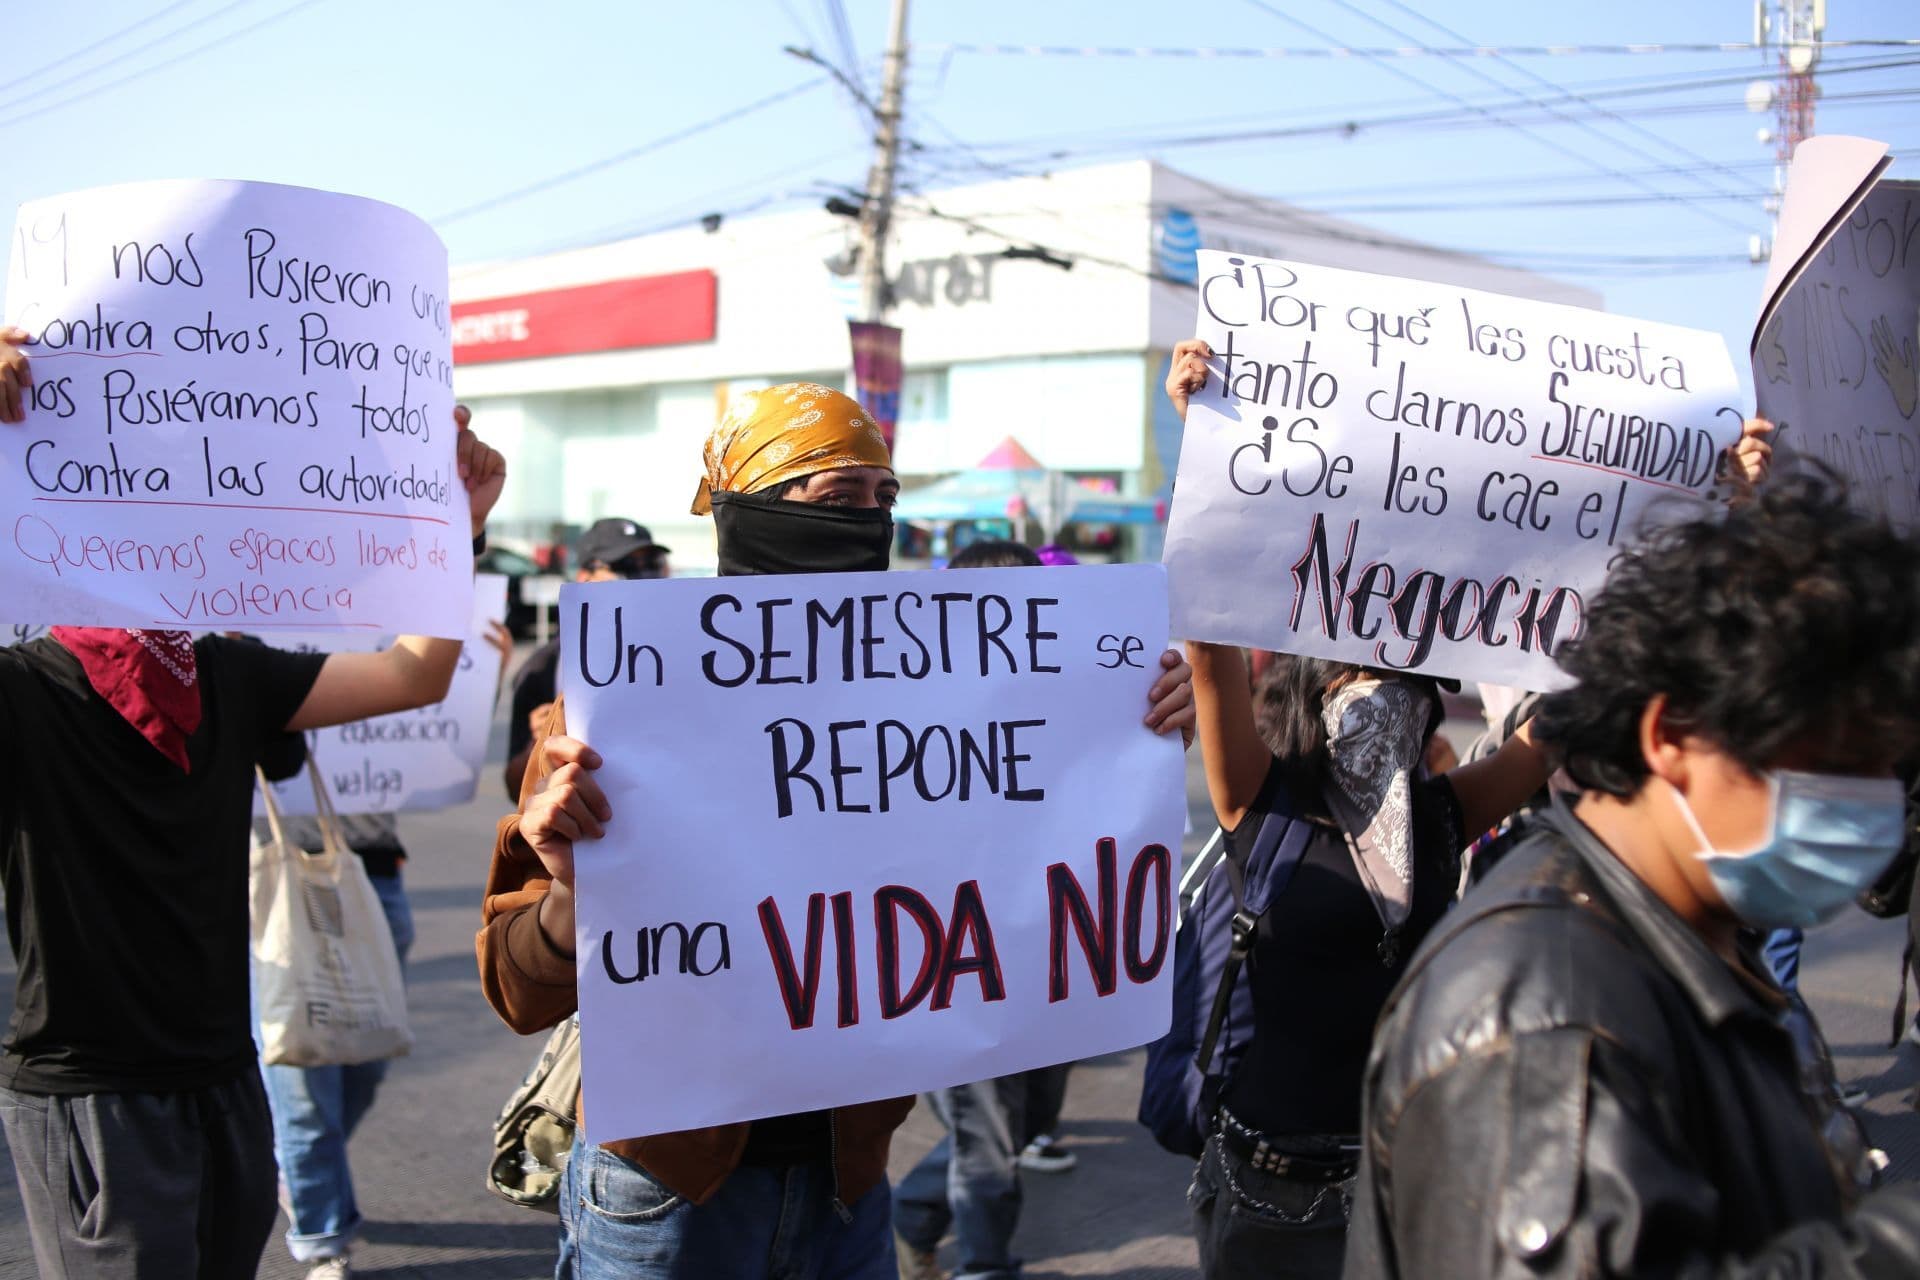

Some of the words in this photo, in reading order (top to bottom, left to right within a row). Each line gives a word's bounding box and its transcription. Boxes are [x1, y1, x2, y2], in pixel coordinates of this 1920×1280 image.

[114, 232, 203, 287] nos
[245, 227, 391, 308] Pusieron
[173, 311, 284, 357] otros,
[299, 312, 379, 375] Para
[394, 344, 433, 406] que
[1201, 257, 1328, 332] ¿Por
[1346, 307, 1438, 368] qué
[1461, 297, 1528, 363] les
[1548, 331, 1694, 394] cuesta
[104, 369, 319, 434] Pusiéramos
[351, 384, 430, 443] todos
[1214, 330, 1339, 411] tanto
[1366, 360, 1528, 447] darnos
[25, 439, 170, 498] Contra
[203, 436, 268, 498] las
[1228, 415, 1354, 500] ¿Se
[1383, 431, 1449, 517] les
[1477, 469, 1560, 532] cae
[1575, 481, 1629, 547] el
[14, 513, 206, 580] Queremos
[229, 526, 337, 575] espacios
[358, 527, 419, 571] libres
[428, 536, 449, 571] de
[159, 581, 353, 621] violencia
[578, 600, 665, 689] Un
[699, 590, 1062, 689] SEMESTRE
[1095, 632, 1146, 670] se
[763, 717, 1047, 819] REPONE
[601, 921, 732, 985] una
[756, 880, 1007, 1031] VIDA
[1046, 836, 1172, 1004] NO
